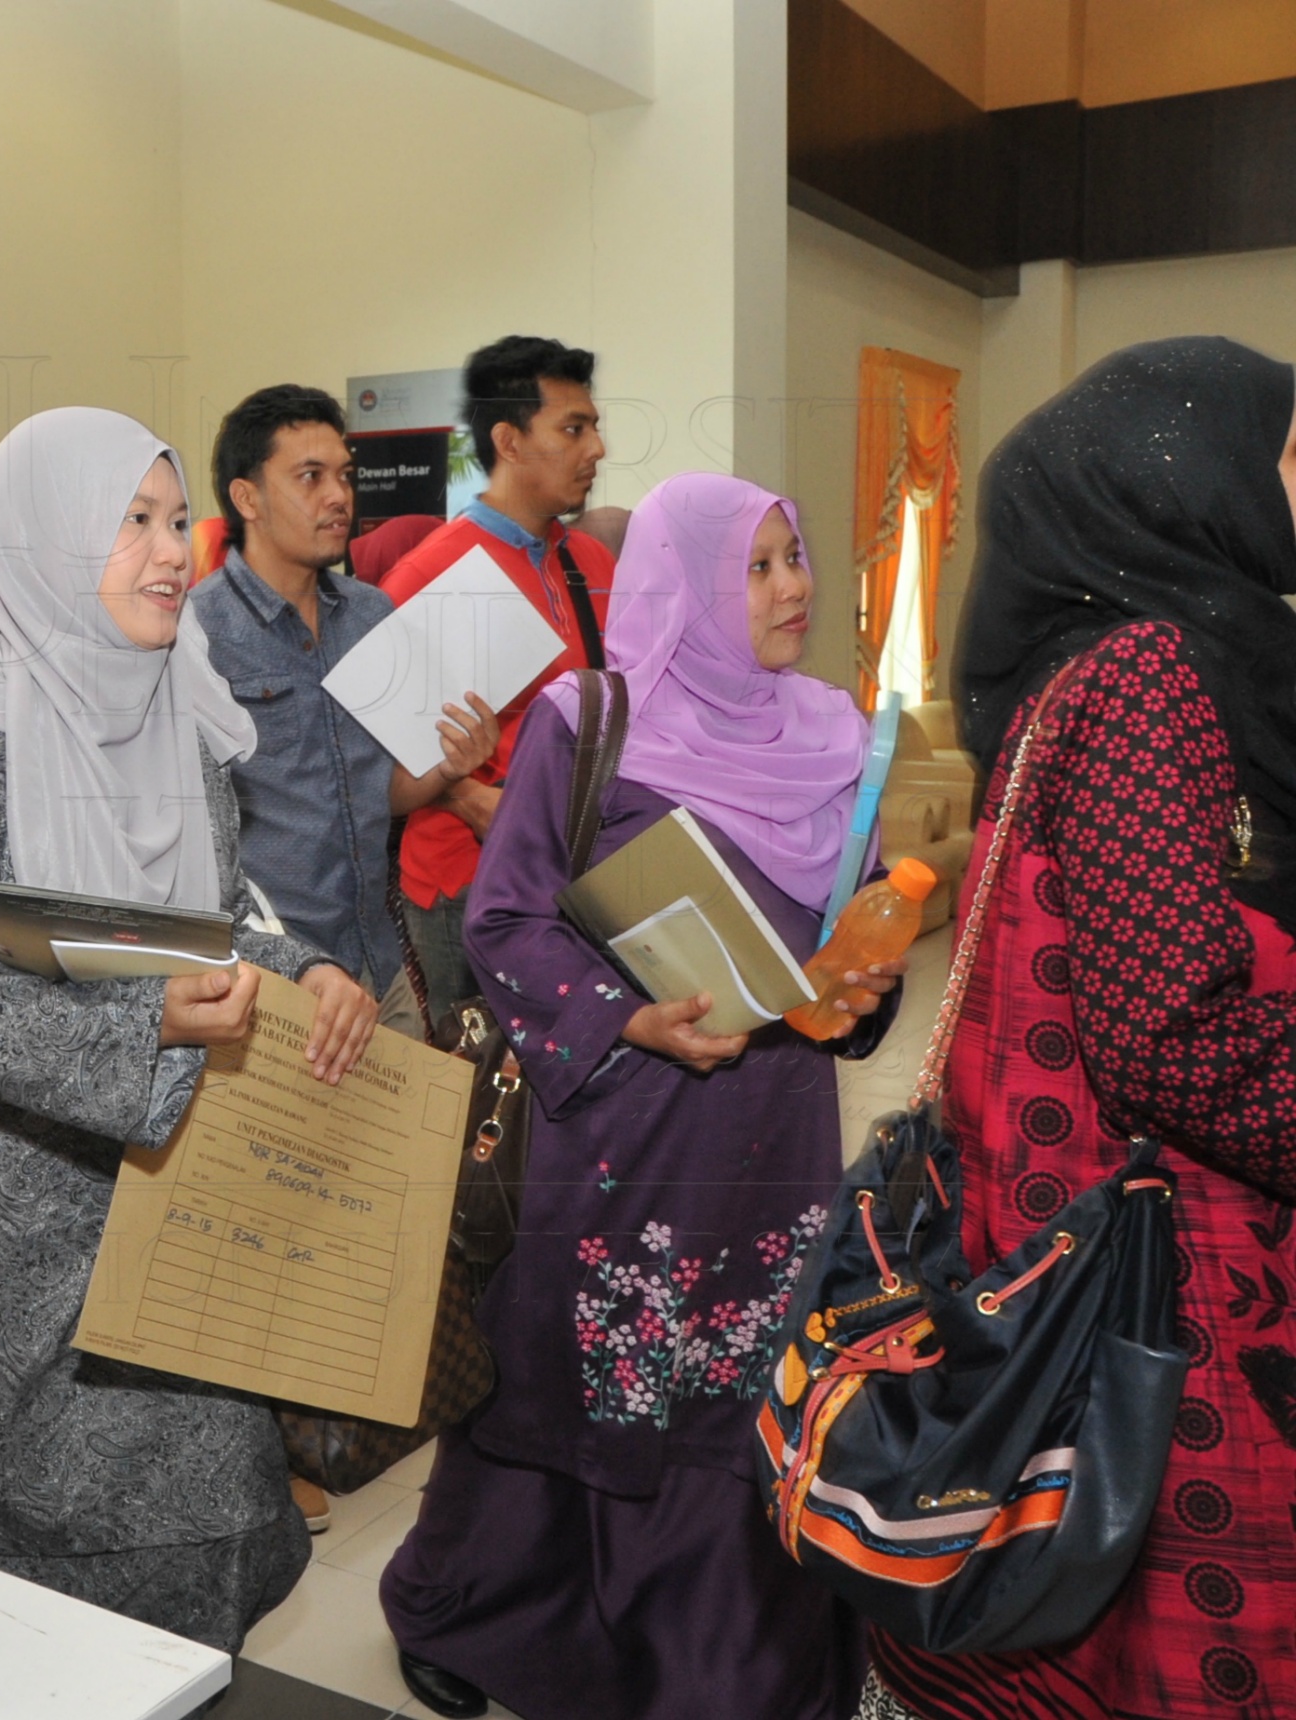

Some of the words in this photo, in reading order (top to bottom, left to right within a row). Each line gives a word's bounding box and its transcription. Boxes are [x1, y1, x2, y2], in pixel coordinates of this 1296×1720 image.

[358, 466, 396, 478] Dewan
[398, 464, 430, 476] Besar
[380, 480, 397, 490] Hall
[365, 1057, 407, 1085] MALAYSIA
[364, 1073, 399, 1096] GOMBAK
[237, 1121, 256, 1136] UNIT
[257, 1128, 305, 1154] PENGIMEJAN
[306, 1148, 350, 1172] DIAGNOSTIK
